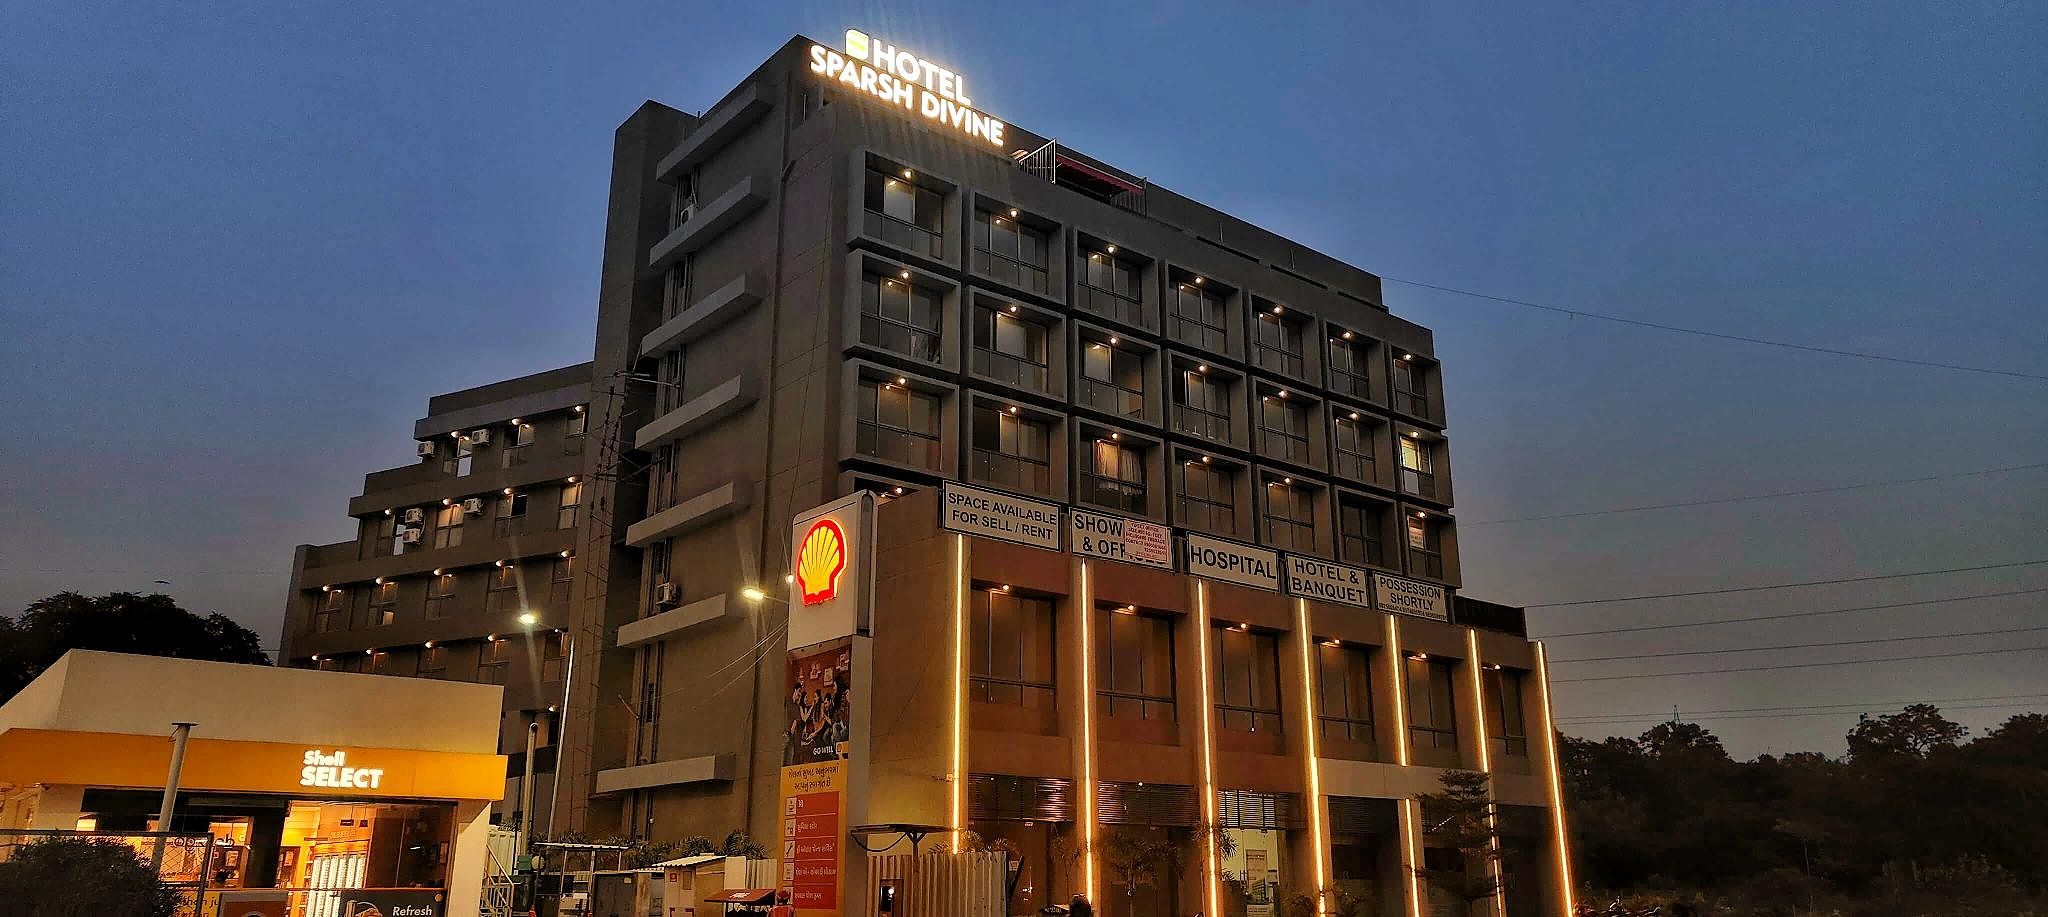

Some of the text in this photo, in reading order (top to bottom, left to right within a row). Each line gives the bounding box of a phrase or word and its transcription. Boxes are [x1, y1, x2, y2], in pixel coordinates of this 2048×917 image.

[872, 38, 971, 106] HOTEL
[810, 44, 1004, 147] SPARSH DIVINE
[948, 492, 1057, 525] SPACE AVAILABLE
[952, 510, 978, 525] FOR
[982, 516, 1012, 532] SELL
[1022, 524, 1053, 540] RENT
[1075, 514, 1123, 537] SHOW
[1083, 536, 1093, 553] &
[1190, 545, 1277, 580] HOSPITAL
[1295, 560, 1360, 584] HOTEL &
[1292, 577, 1365, 603] BANQUET
[1380, 577, 1441, 600] POSSESSION
[1390, 593, 1434, 611] SHORTLY
[303, 749, 346, 767] Shell
[299, 766, 384, 789] SELECT
[393, 904, 433, 917] Refresh
